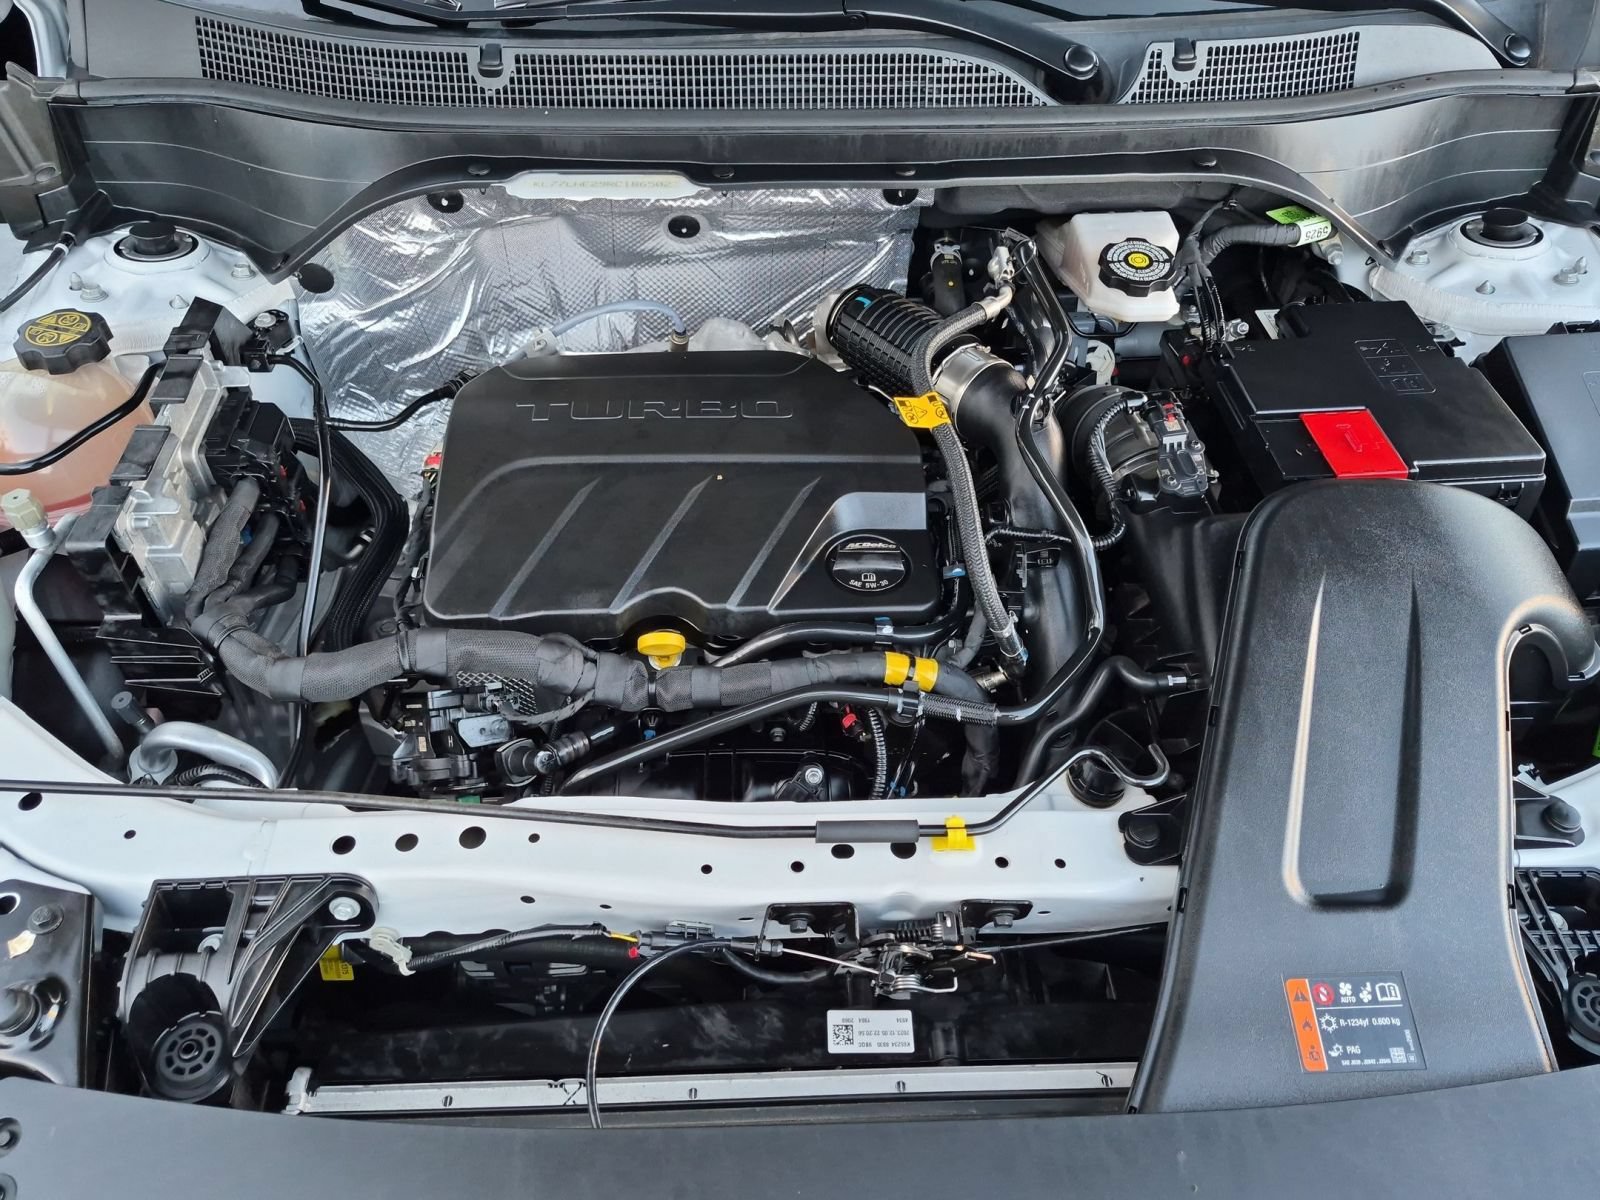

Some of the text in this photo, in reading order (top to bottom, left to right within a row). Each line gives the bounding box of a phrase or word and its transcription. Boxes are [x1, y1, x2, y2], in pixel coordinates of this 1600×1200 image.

[515, 398, 793, 421] TURBO
[844, 542, 897, 550] ACDelco
[849, 579, 889, 589] SAE 5W-30
[1391, 1016, 1401, 1027] kg
[1346, 1045, 1361, 1055] PAG
